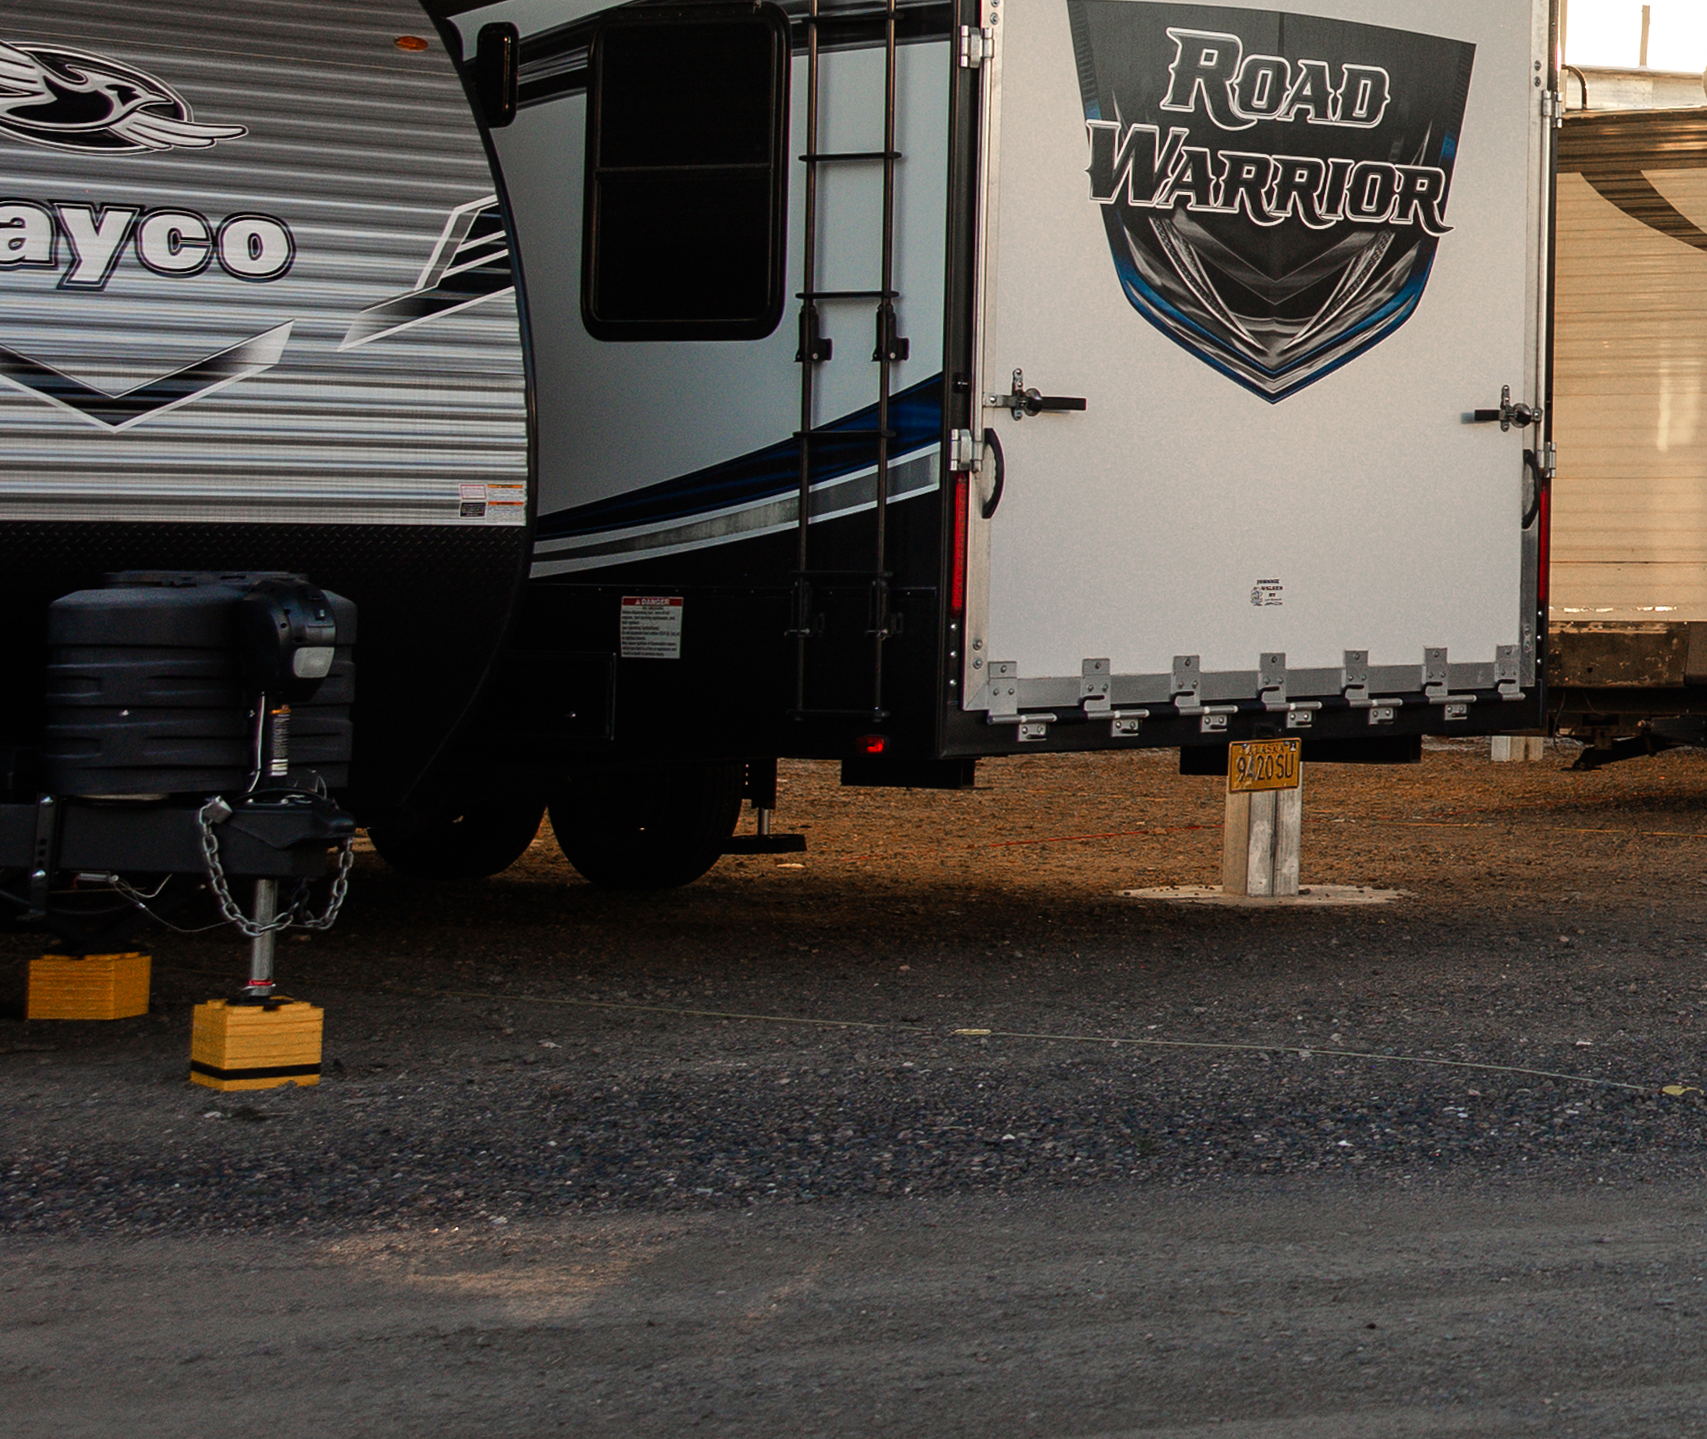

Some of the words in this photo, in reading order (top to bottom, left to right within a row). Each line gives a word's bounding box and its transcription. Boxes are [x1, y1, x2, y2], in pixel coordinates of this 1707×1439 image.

[1160, 26, 1391, 130] ROAD
[1084, 118, 1455, 236] WARRIOR
[0, 197, 297, 292] ayco
